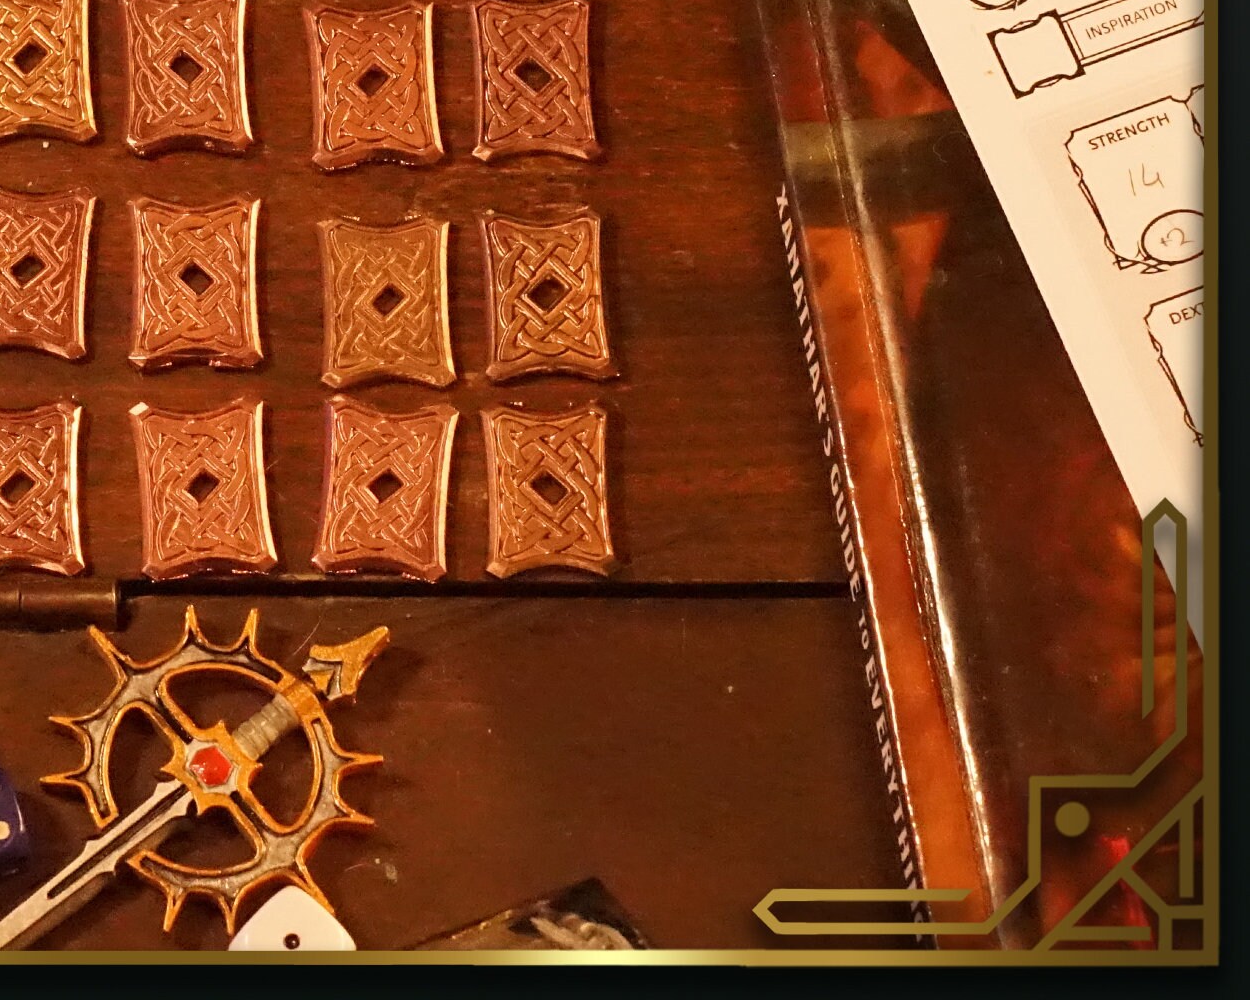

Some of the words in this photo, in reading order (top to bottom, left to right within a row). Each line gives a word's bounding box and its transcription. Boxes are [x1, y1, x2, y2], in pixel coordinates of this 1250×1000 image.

[1088, 112, 1170, 151] STRENGTH
[1127, 161, 1164, 197] 14
[776, 182, 834, 458] XANATHAR'S
[830, 463, 861, 602] GUIDE
